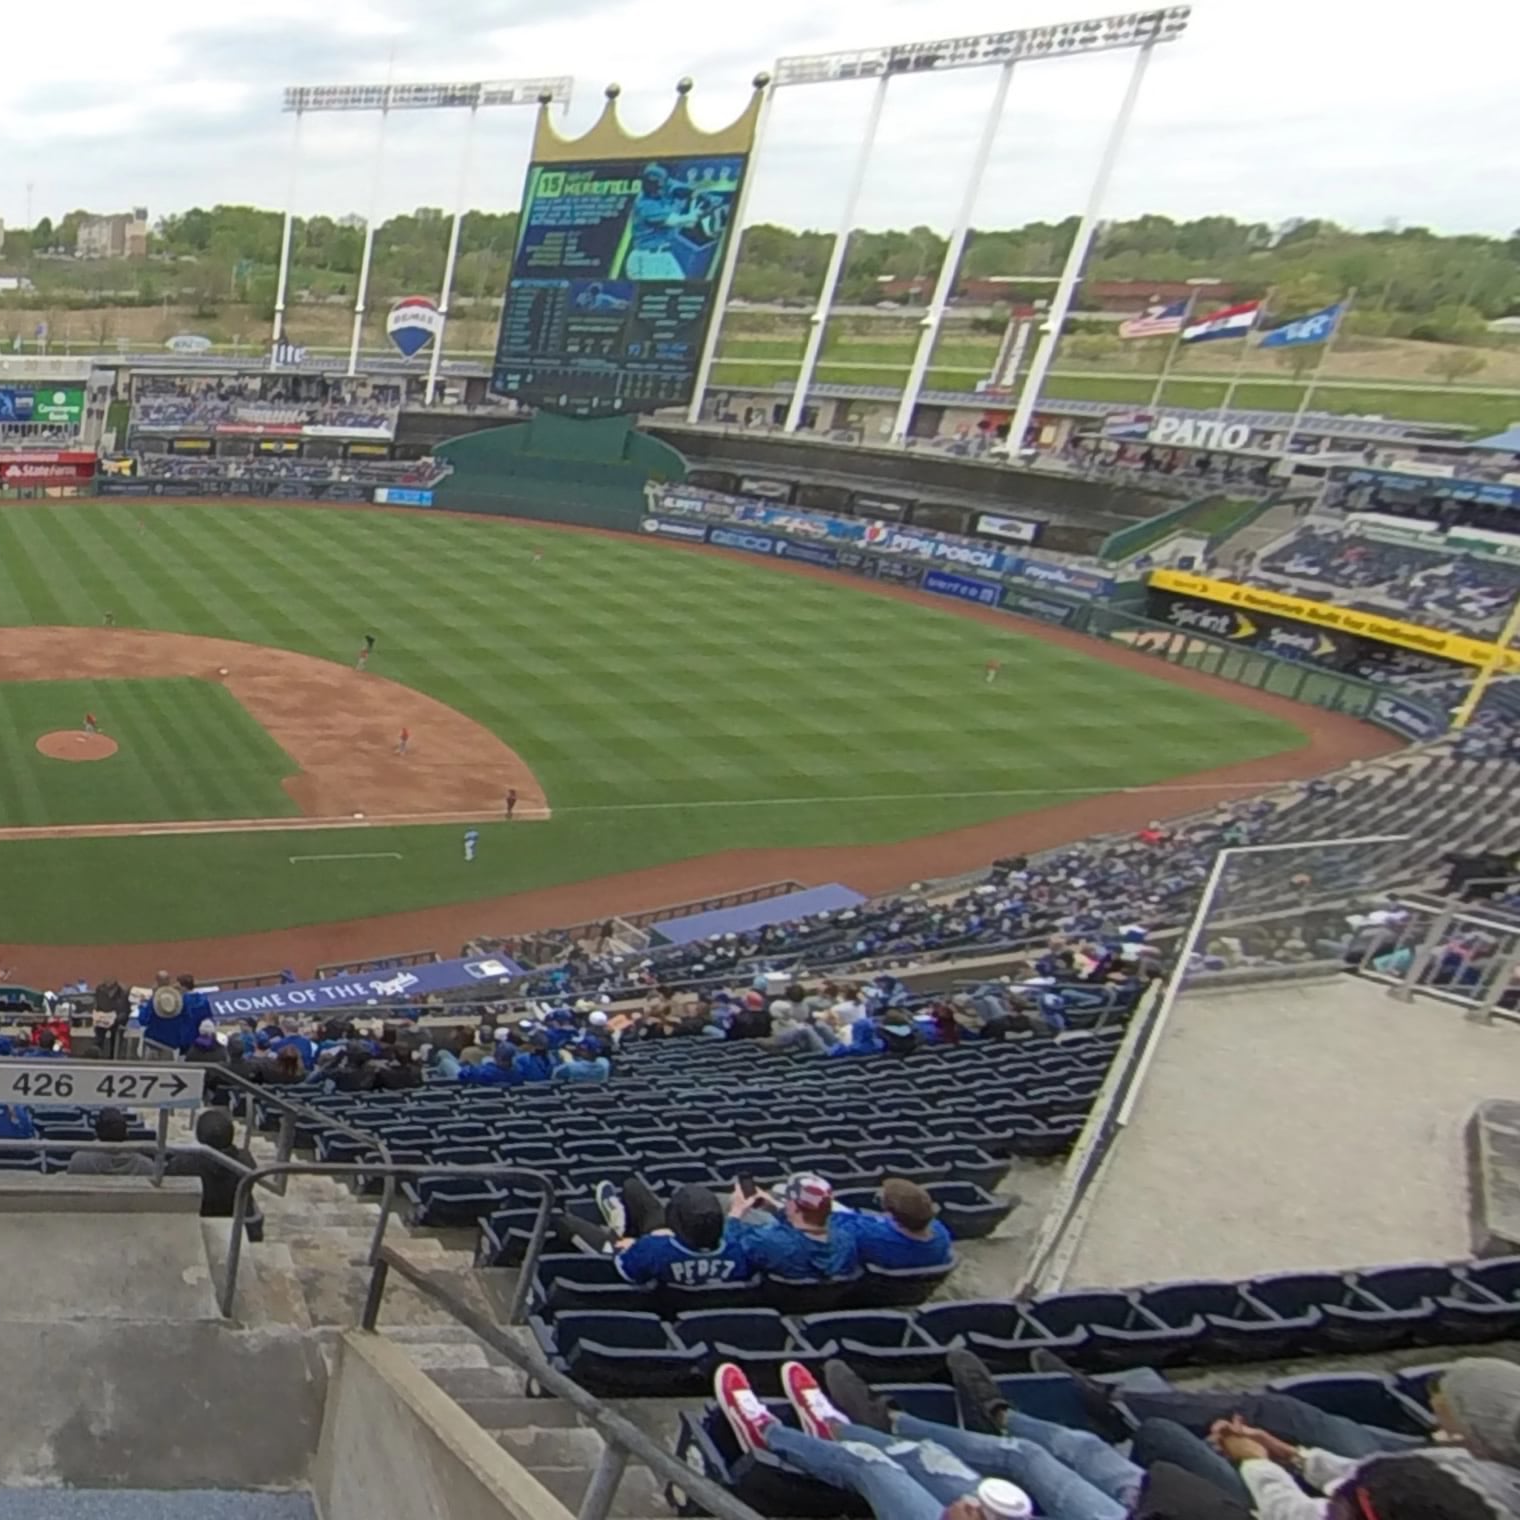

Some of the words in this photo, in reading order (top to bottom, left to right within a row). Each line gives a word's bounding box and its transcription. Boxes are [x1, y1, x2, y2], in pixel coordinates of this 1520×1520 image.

[542, 176, 560, 193] 15
[1149, 417, 1250, 449] PATIO
[709, 529, 772, 551] GEICO
[891, 533, 934, 555] PEPSI
[935, 544, 996, 568] PORCH
[1168, 602, 1230, 635] Sprint
[1269, 627, 1315, 650] Sprint
[214, 994, 286, 1016] HOME
[288, 986, 317, 1006] OF
[318, 980, 370, 1001] THE
[369, 971, 419, 997] Royals
[12, 1073, 74, 1098] 426
[96, 1074, 159, 1099] 427
[670, 1259, 737, 1283] PEREZ
